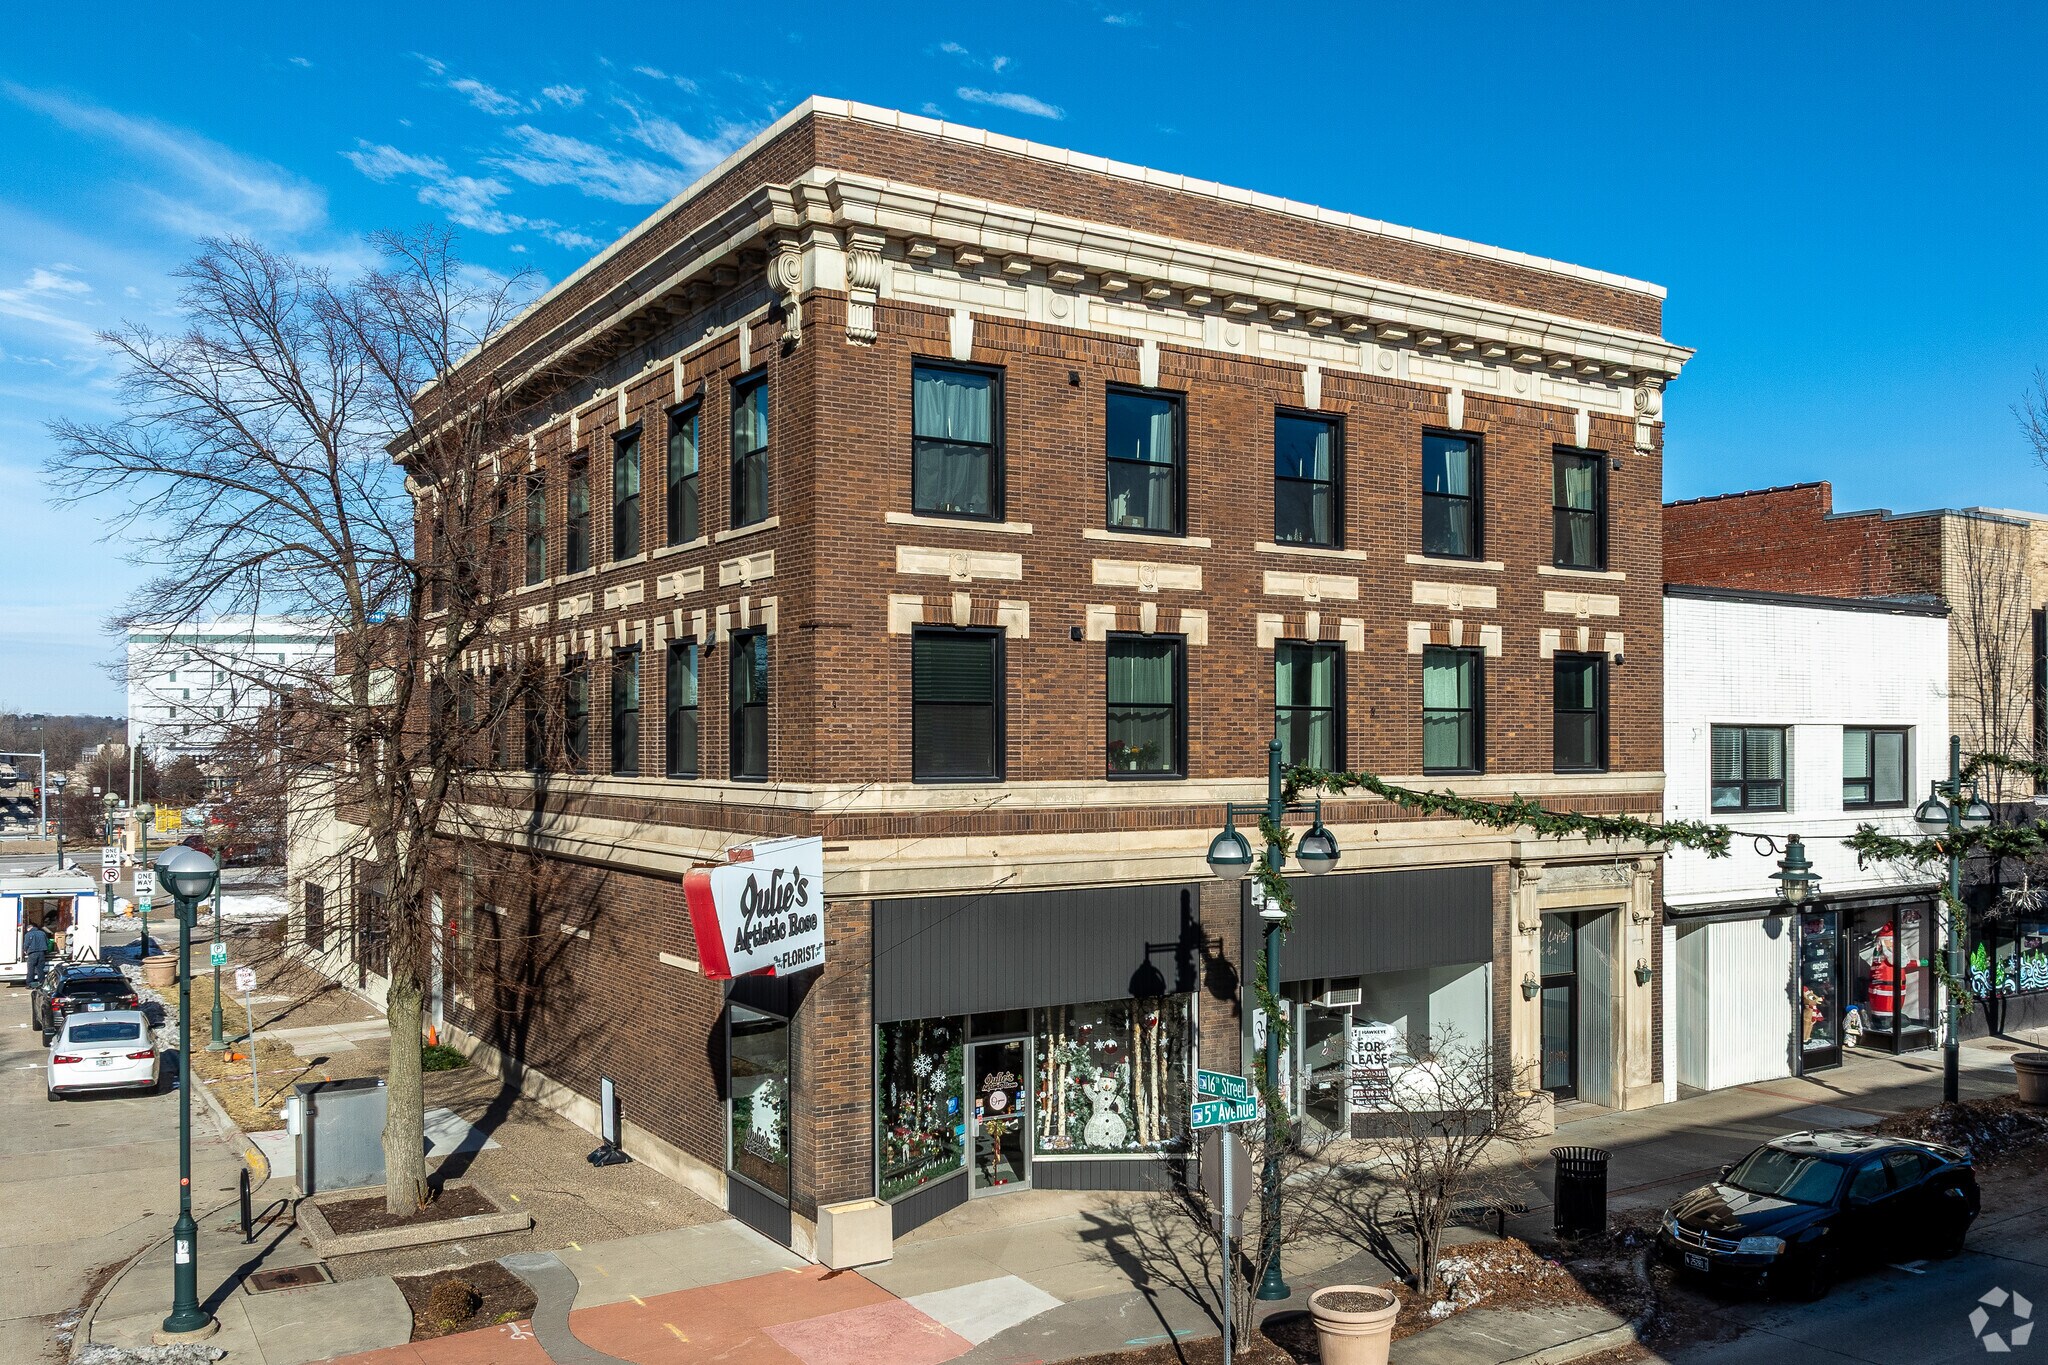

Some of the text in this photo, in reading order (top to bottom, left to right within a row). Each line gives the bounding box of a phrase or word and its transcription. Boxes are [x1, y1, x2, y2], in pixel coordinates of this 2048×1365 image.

[740, 865, 809, 955] Julie's
[734, 912, 818, 954] Artistic Rose
[782, 944, 815, 969] FLORIST
[1357, 1041, 1382, 1052] FOR
[1351, 1054, 1388, 1065] LEASE
[1207, 1075, 1245, 1099] 16th Street
[1204, 1103, 1254, 1124] 5th Avenue
